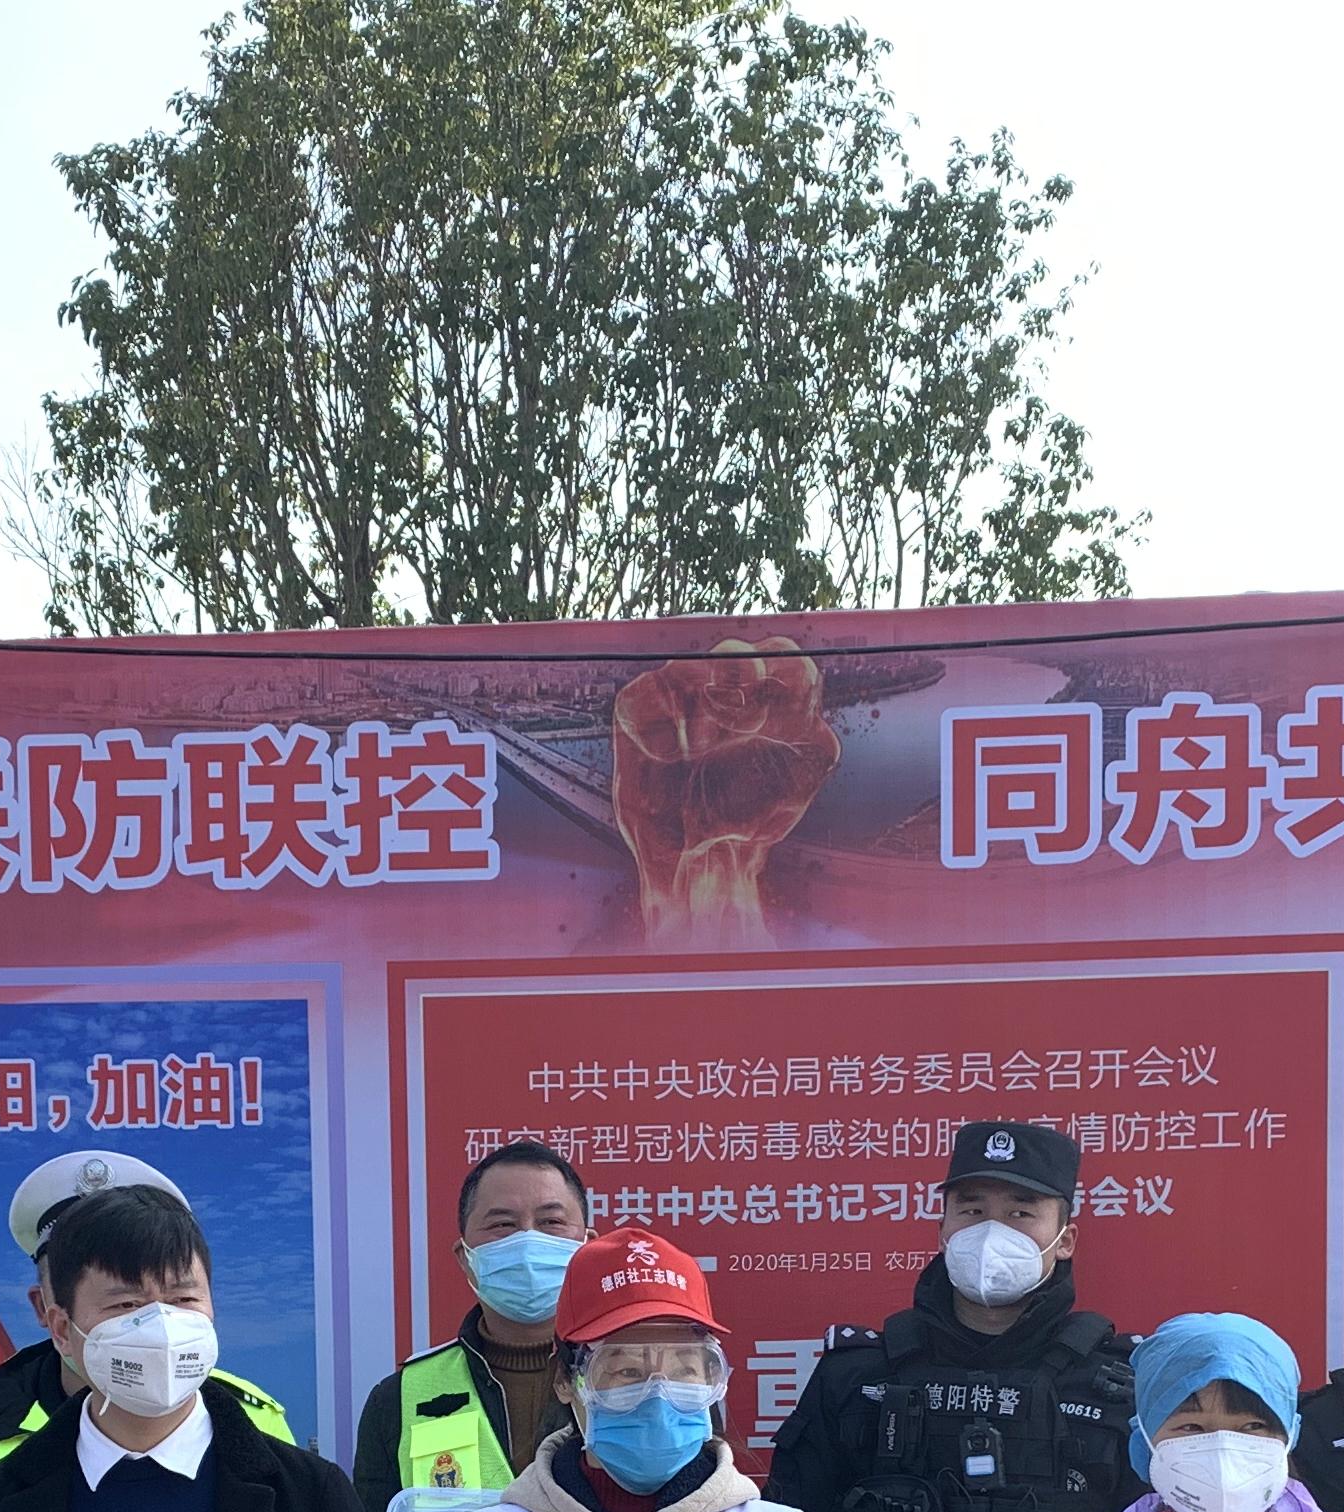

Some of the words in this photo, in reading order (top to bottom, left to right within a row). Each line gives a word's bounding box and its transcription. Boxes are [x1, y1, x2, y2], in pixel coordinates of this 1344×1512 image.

[528, 1044, 1219, 1104] 中共中央政治局常务委员会召开会议
[729, 1251, 872, 1273] 2020年1月25日
[601, 1268, 687, 1293] 德阳社工志愿者
[124, 1361, 143, 1372] 9002
[924, 1382, 1021, 1416] 德阳特警
